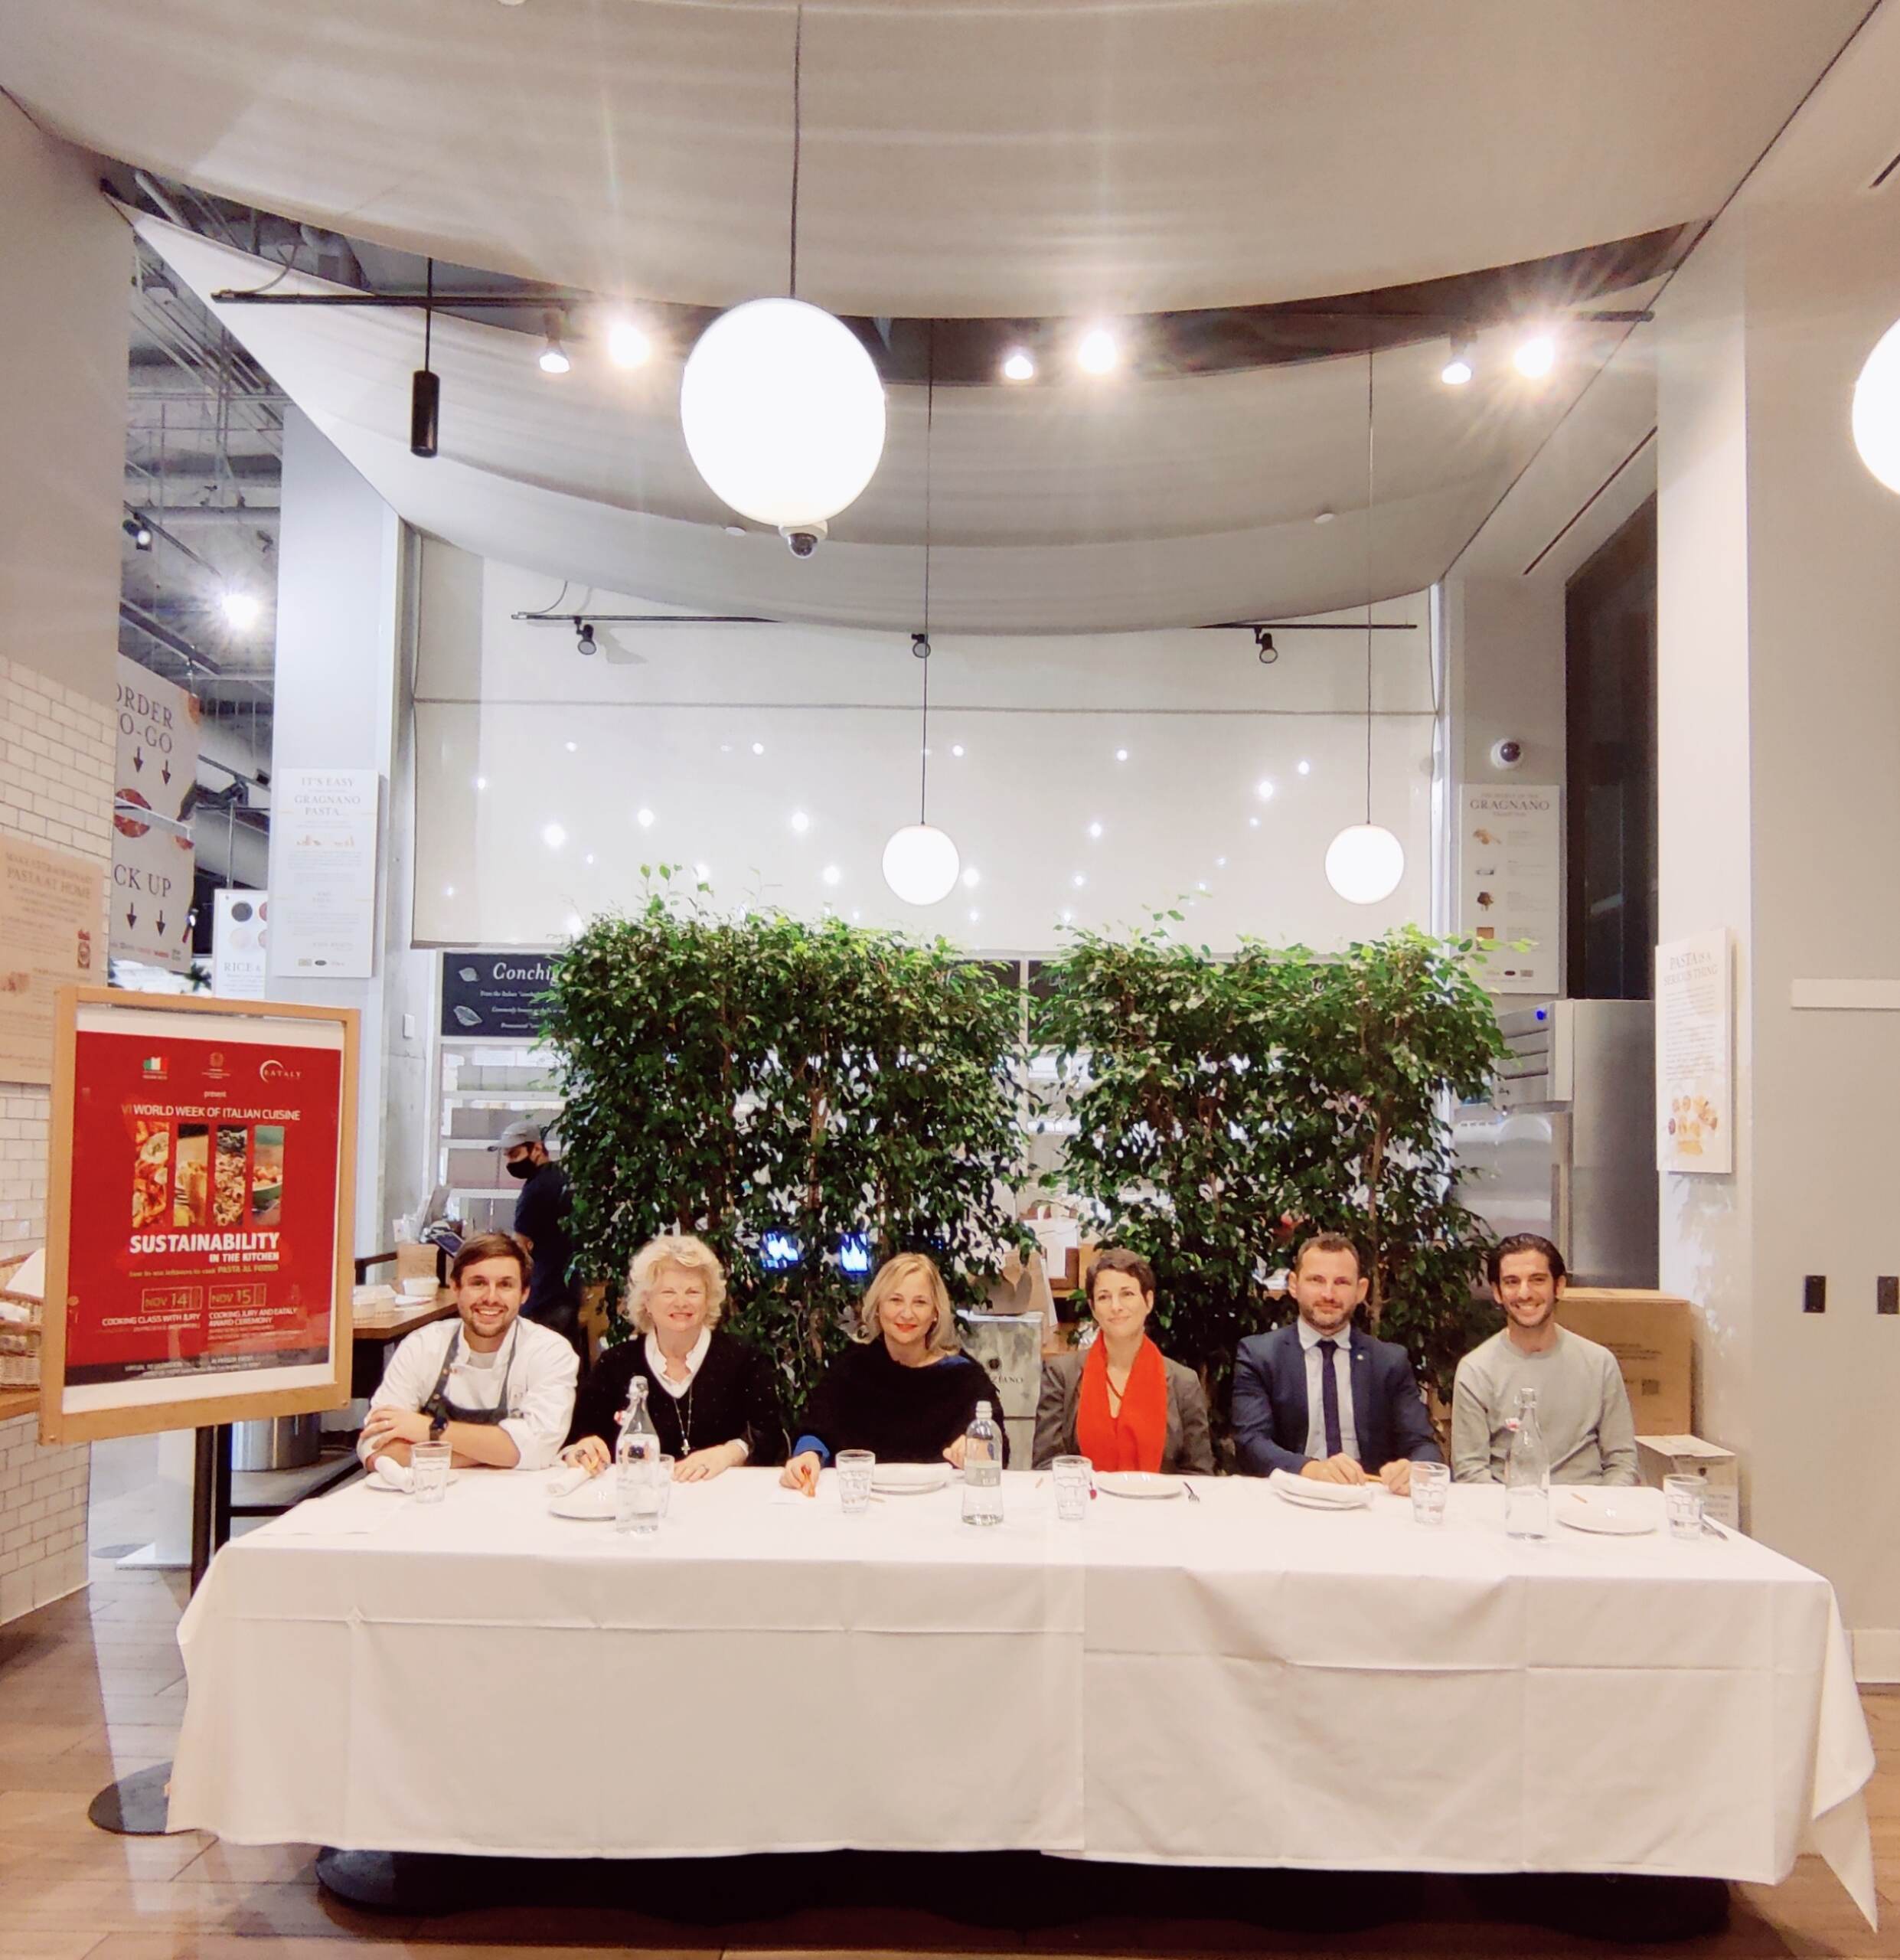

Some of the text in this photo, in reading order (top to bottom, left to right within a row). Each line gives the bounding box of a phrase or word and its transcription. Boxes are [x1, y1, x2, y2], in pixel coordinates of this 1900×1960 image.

[116, 709, 172, 753] O-GO
[326, 776, 354, 787] EASY
[294, 795, 361, 804] GRAGNANO
[1470, 799, 1550, 811] GRAGNANO
[114, 864, 171, 897] CK UP
[224, 962, 253, 972] RICE
[133, 1104, 174, 1116] WORLD
[175, 1106, 205, 1118] WEEK
[207, 1107, 220, 1118] OF
[223, 1108, 261, 1119] ITALIAN
[262, 1109, 301, 1121] CUISINE
[129, 1232, 279, 1253] SUSTAINABILITY
[209, 1251, 279, 1263] IN THE KITCHEN
[217, 1265, 240, 1274] PASTA
[145, 1292, 188, 1307] NOV 14
[211, 1289, 251, 1304] NOV 15
[102, 1312, 201, 1326] COOKING CLASS WITH JURY
